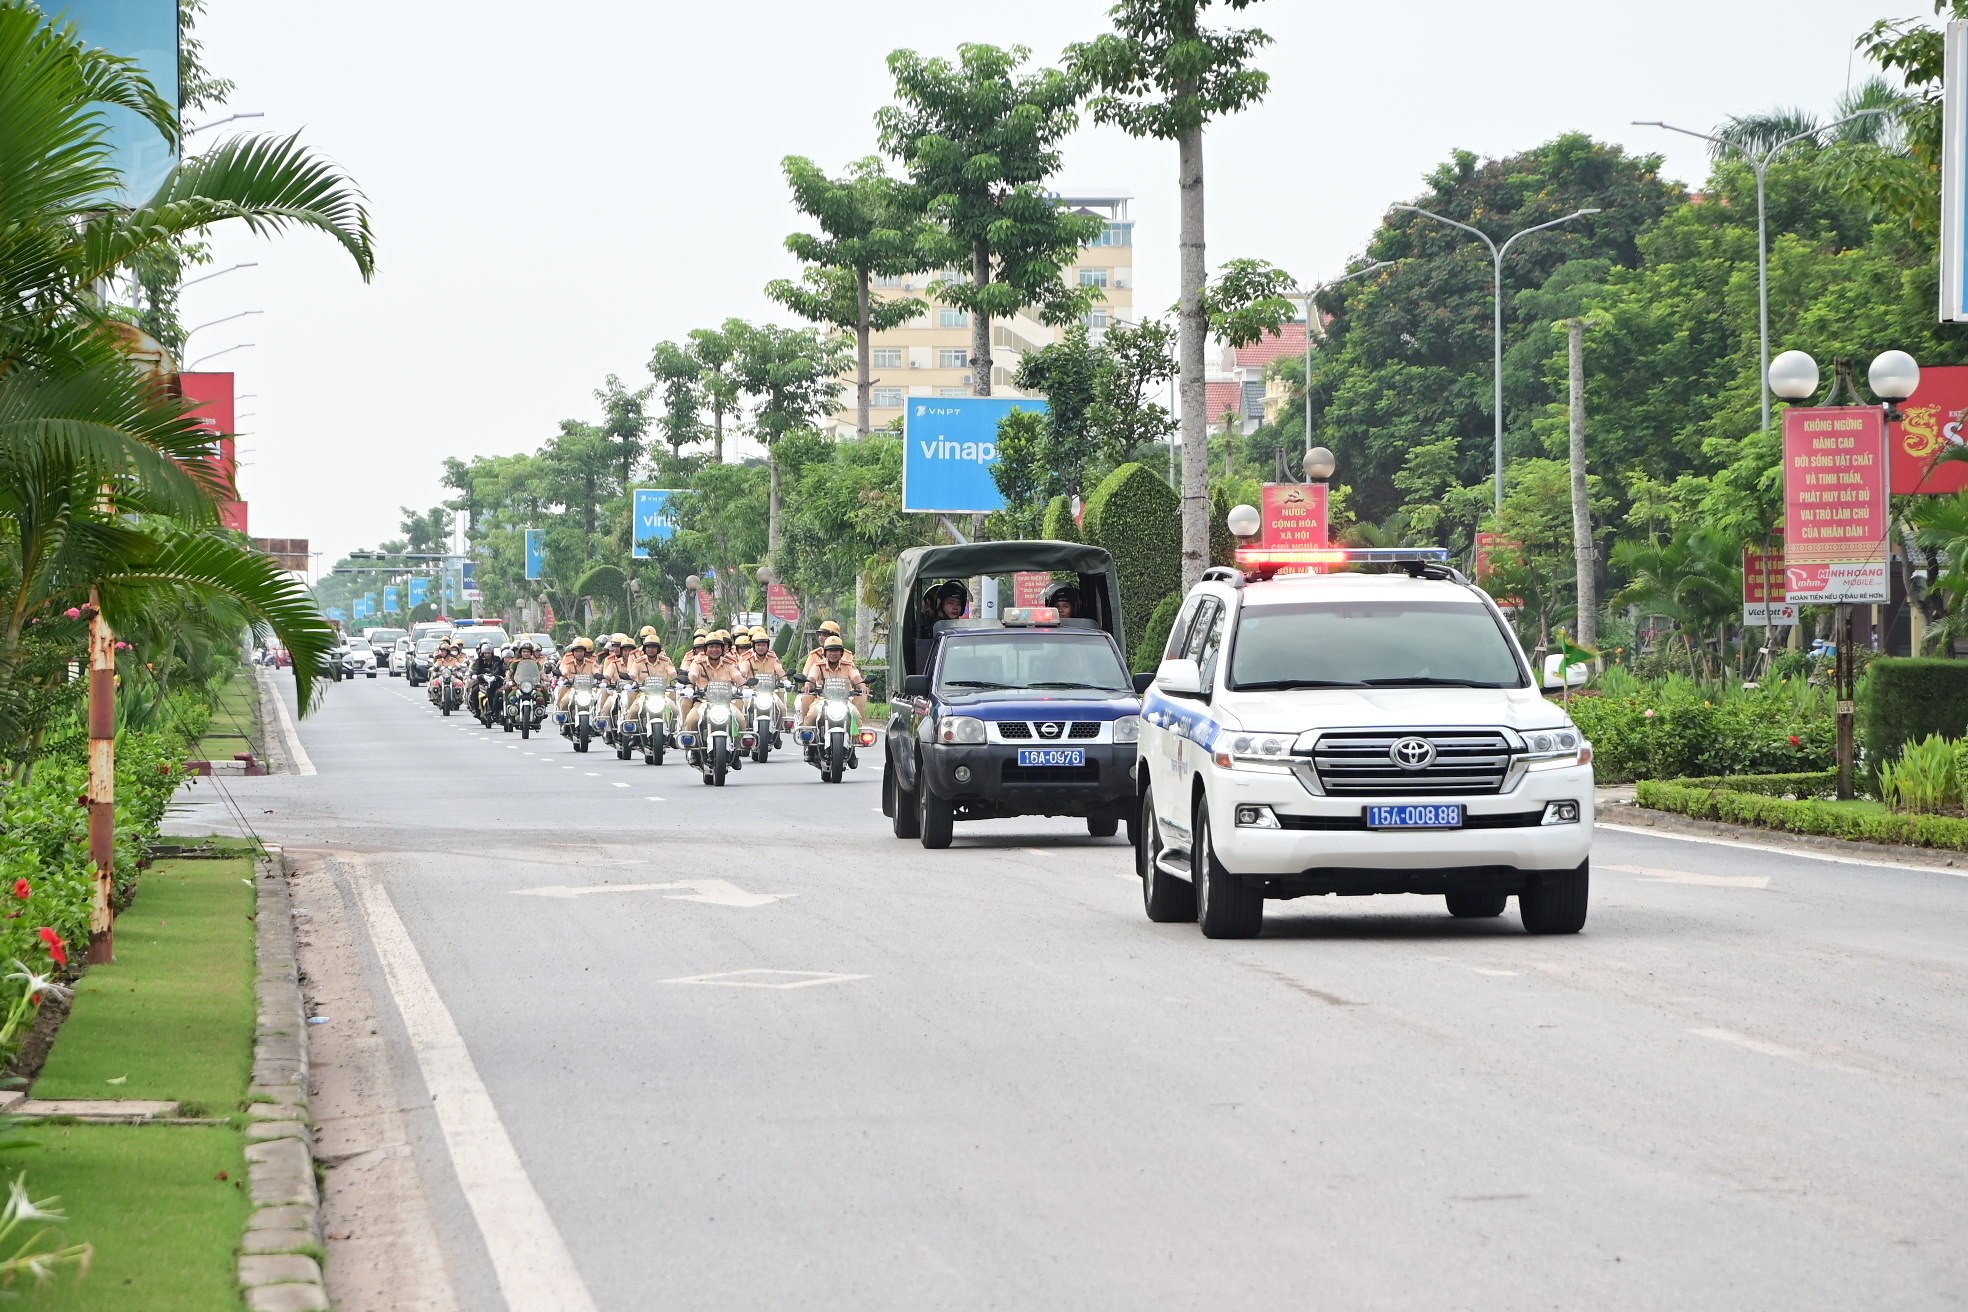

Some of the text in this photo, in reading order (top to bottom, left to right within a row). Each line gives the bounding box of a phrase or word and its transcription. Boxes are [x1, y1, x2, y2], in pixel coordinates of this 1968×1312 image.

[928, 408, 961, 416] VNPT
[1803, 417, 1863, 432] KHÔNG NGỪNG
[1812, 436, 1855, 449] NÂNG CAO
[920, 435, 999, 464] vinap
[1794, 450, 1874, 469] ĐỜI SỐNG VẬT CHẤT
[1805, 471, 1817, 485] VÀ
[1818, 473, 1838, 485] TINH
[1799, 489, 1821, 503] PHÁT
[1822, 490, 1839, 503] HUY
[1858, 486, 1870, 501] ĐỦ
[1281, 507, 1307, 517] NƯỚC
[1800, 504, 1870, 521] VAI TRÒ LÀM CHỦ
[1271, 517, 1318, 530] CỘNG HÒA
[1279, 529, 1310, 541] XÃ HỘI
[1801, 524, 1869, 538] CỦA NHÂN DÂN !
[1817, 568, 1883, 578] MINH HOANG
[1789, 593, 1808, 601] HOÀN
[1747, 608, 1781, 616] Vietott
[1024, 751, 1081, 764] 16A-0976
[1372, 806, 1459, 825] 15A-008.88
